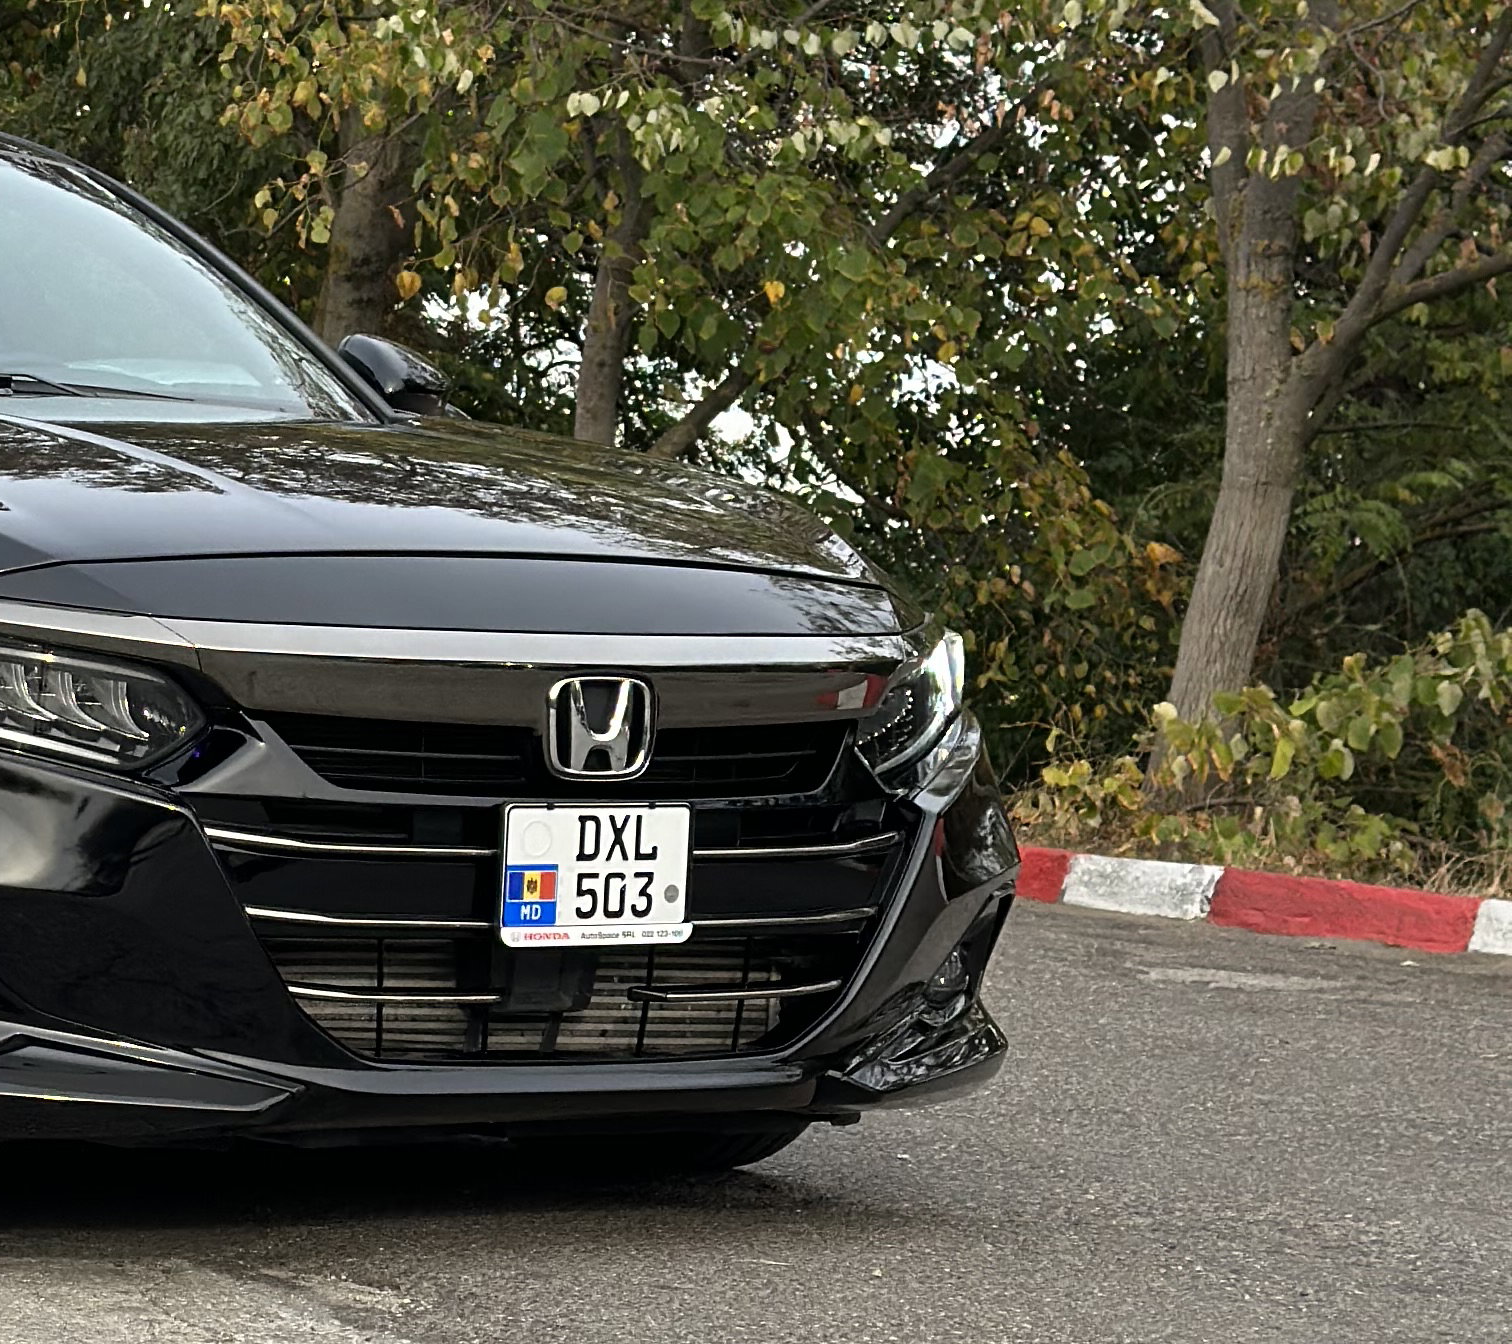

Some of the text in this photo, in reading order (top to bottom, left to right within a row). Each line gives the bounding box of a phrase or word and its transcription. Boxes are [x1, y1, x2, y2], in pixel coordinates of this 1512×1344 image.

[575, 814, 659, 862] DXL
[520, 903, 542, 921] MD
[575, 871, 655, 920] 503
[523, 932, 570, 941] HONDA
